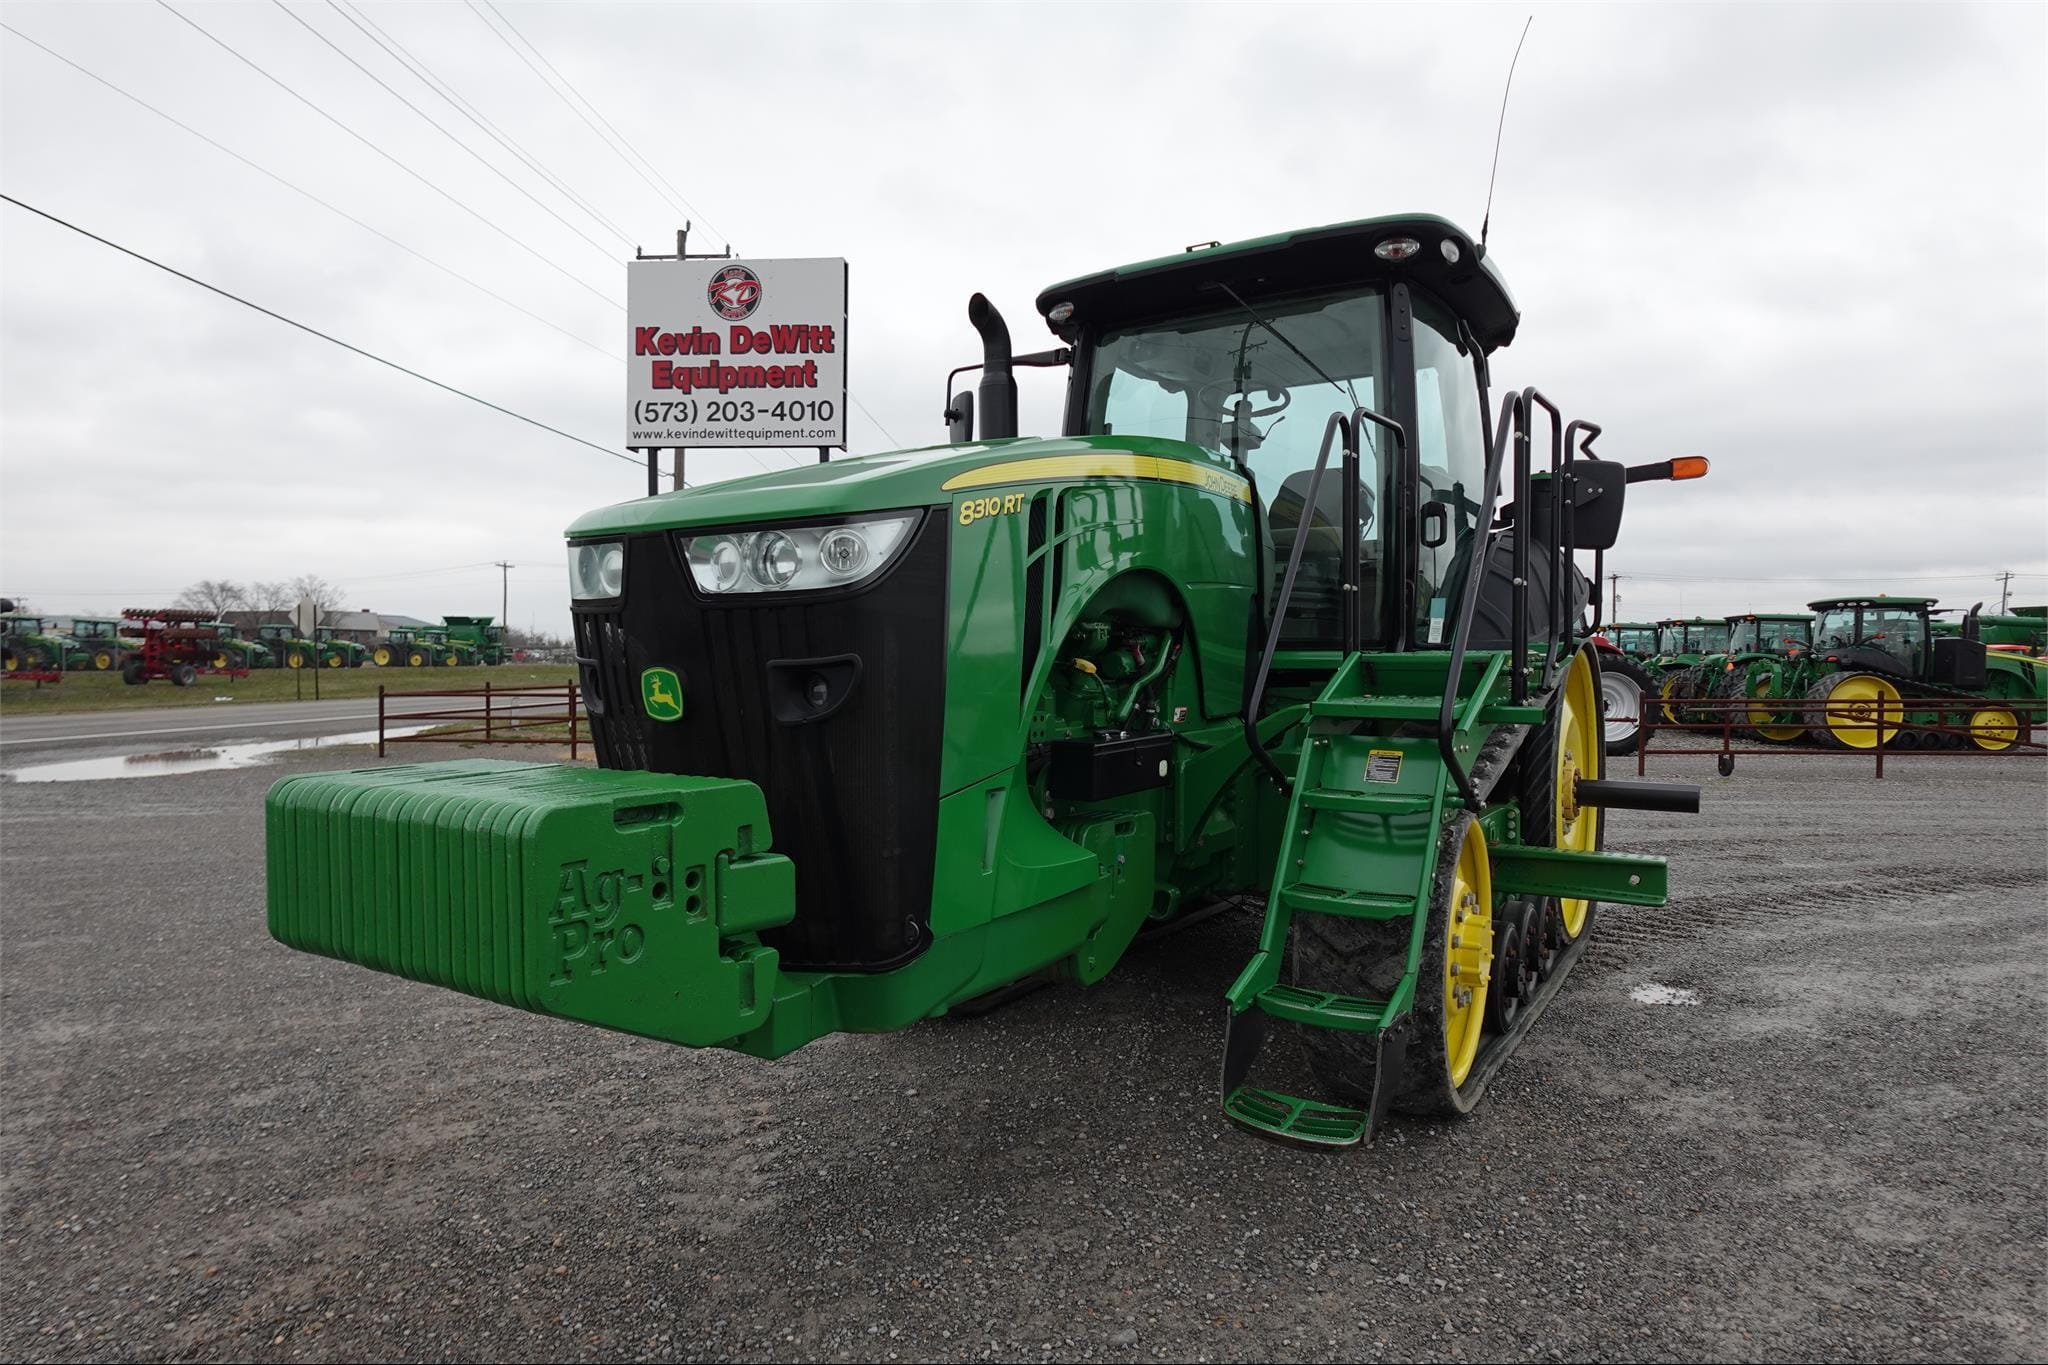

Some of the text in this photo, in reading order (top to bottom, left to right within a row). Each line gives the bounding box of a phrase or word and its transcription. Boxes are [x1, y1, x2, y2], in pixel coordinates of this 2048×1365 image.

[635, 324, 835, 356] Kevin DeWitt
[652, 360, 818, 395] Equipment
[634, 400, 834, 424] (573) 203-4010
[632, 428, 836, 440] www.kevindewittequipment.com
[959, 493, 1026, 526] 8310 RT
[549, 920, 645, 987] Pro
